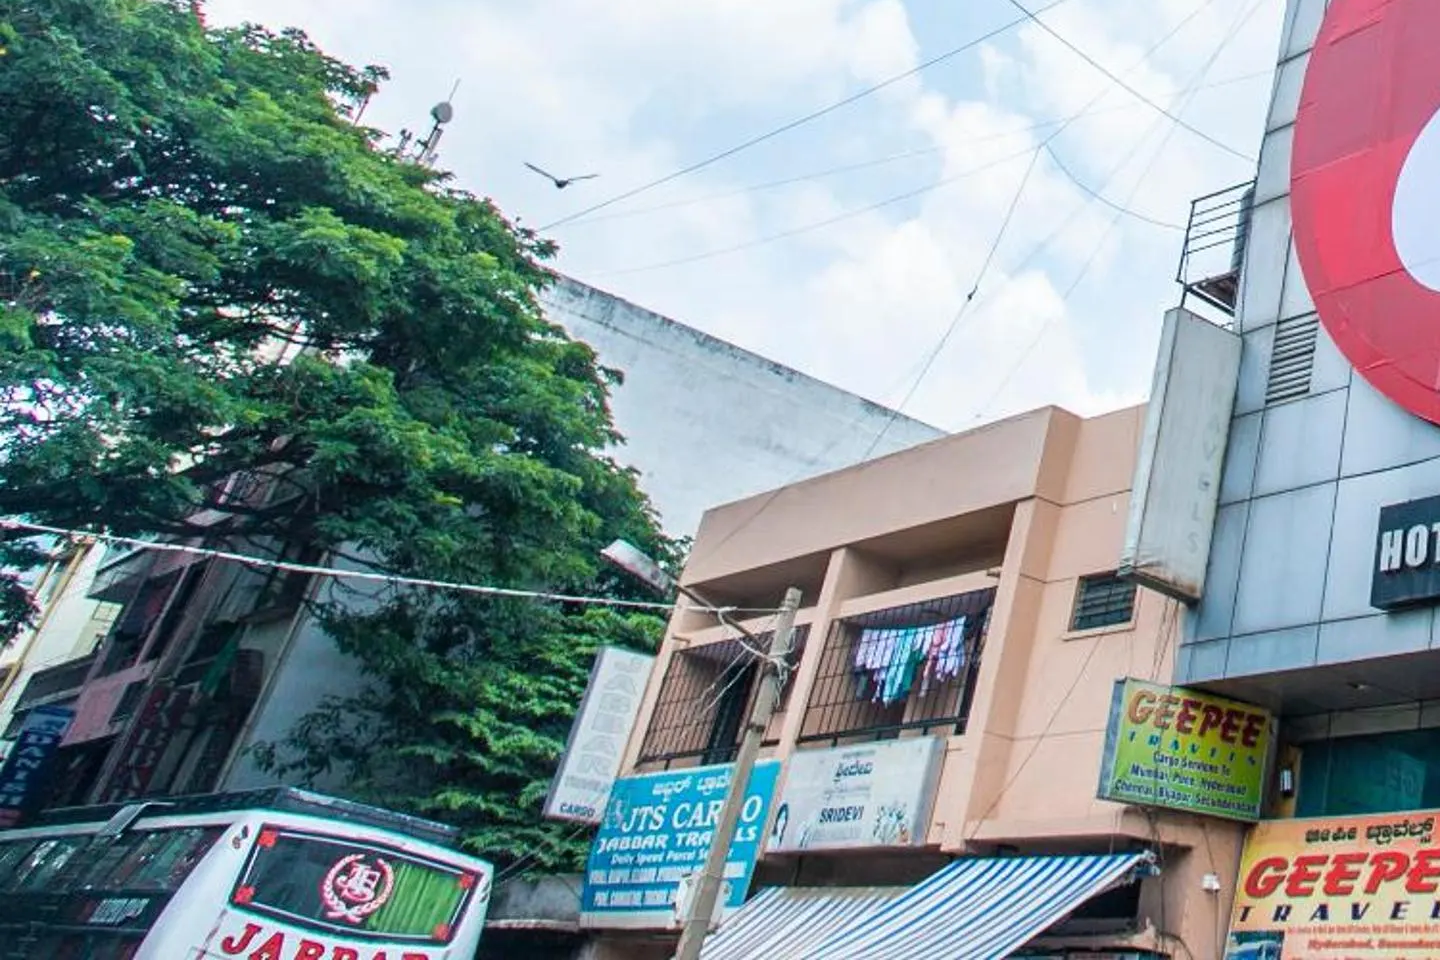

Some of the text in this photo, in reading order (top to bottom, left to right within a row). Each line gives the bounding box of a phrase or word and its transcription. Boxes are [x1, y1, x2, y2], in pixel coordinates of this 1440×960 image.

[1128, 688, 1267, 748] GEEPEE
[1153, 751, 1179, 769] Cargo
[559, 801, 596, 818] CARGO
[621, 794, 764, 833] JTS CARO
[819, 805, 865, 824] SRIDEVI
[596, 825, 759, 855] JABBAR TRALS
